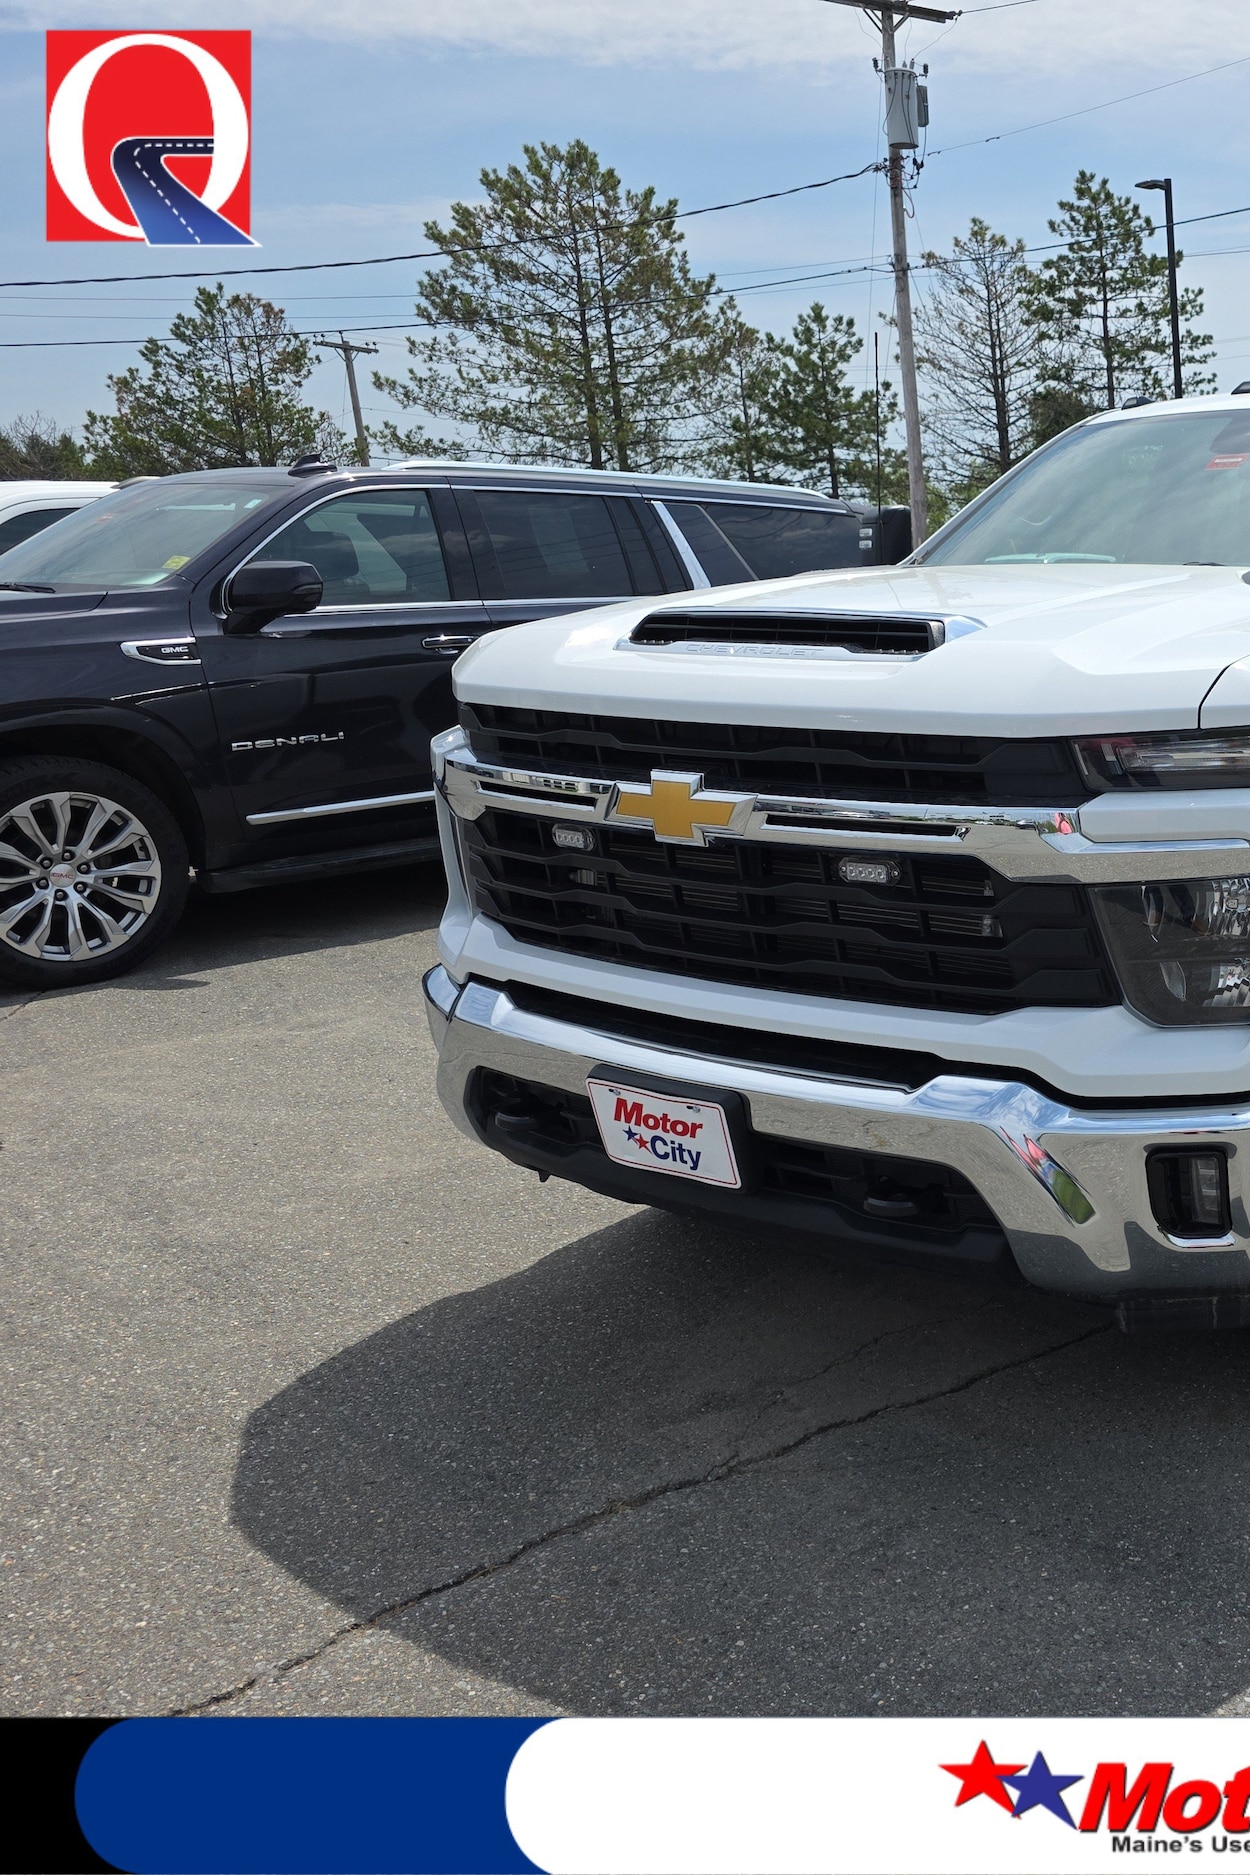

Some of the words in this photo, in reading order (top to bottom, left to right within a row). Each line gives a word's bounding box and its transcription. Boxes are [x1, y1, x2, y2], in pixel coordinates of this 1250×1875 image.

[161, 646, 189, 654] GMC
[685, 643, 825, 657] CHEVROLET
[231, 731, 344, 752] DENALI
[614, 1097, 703, 1139] Motor
[650, 1135, 701, 1171] City
